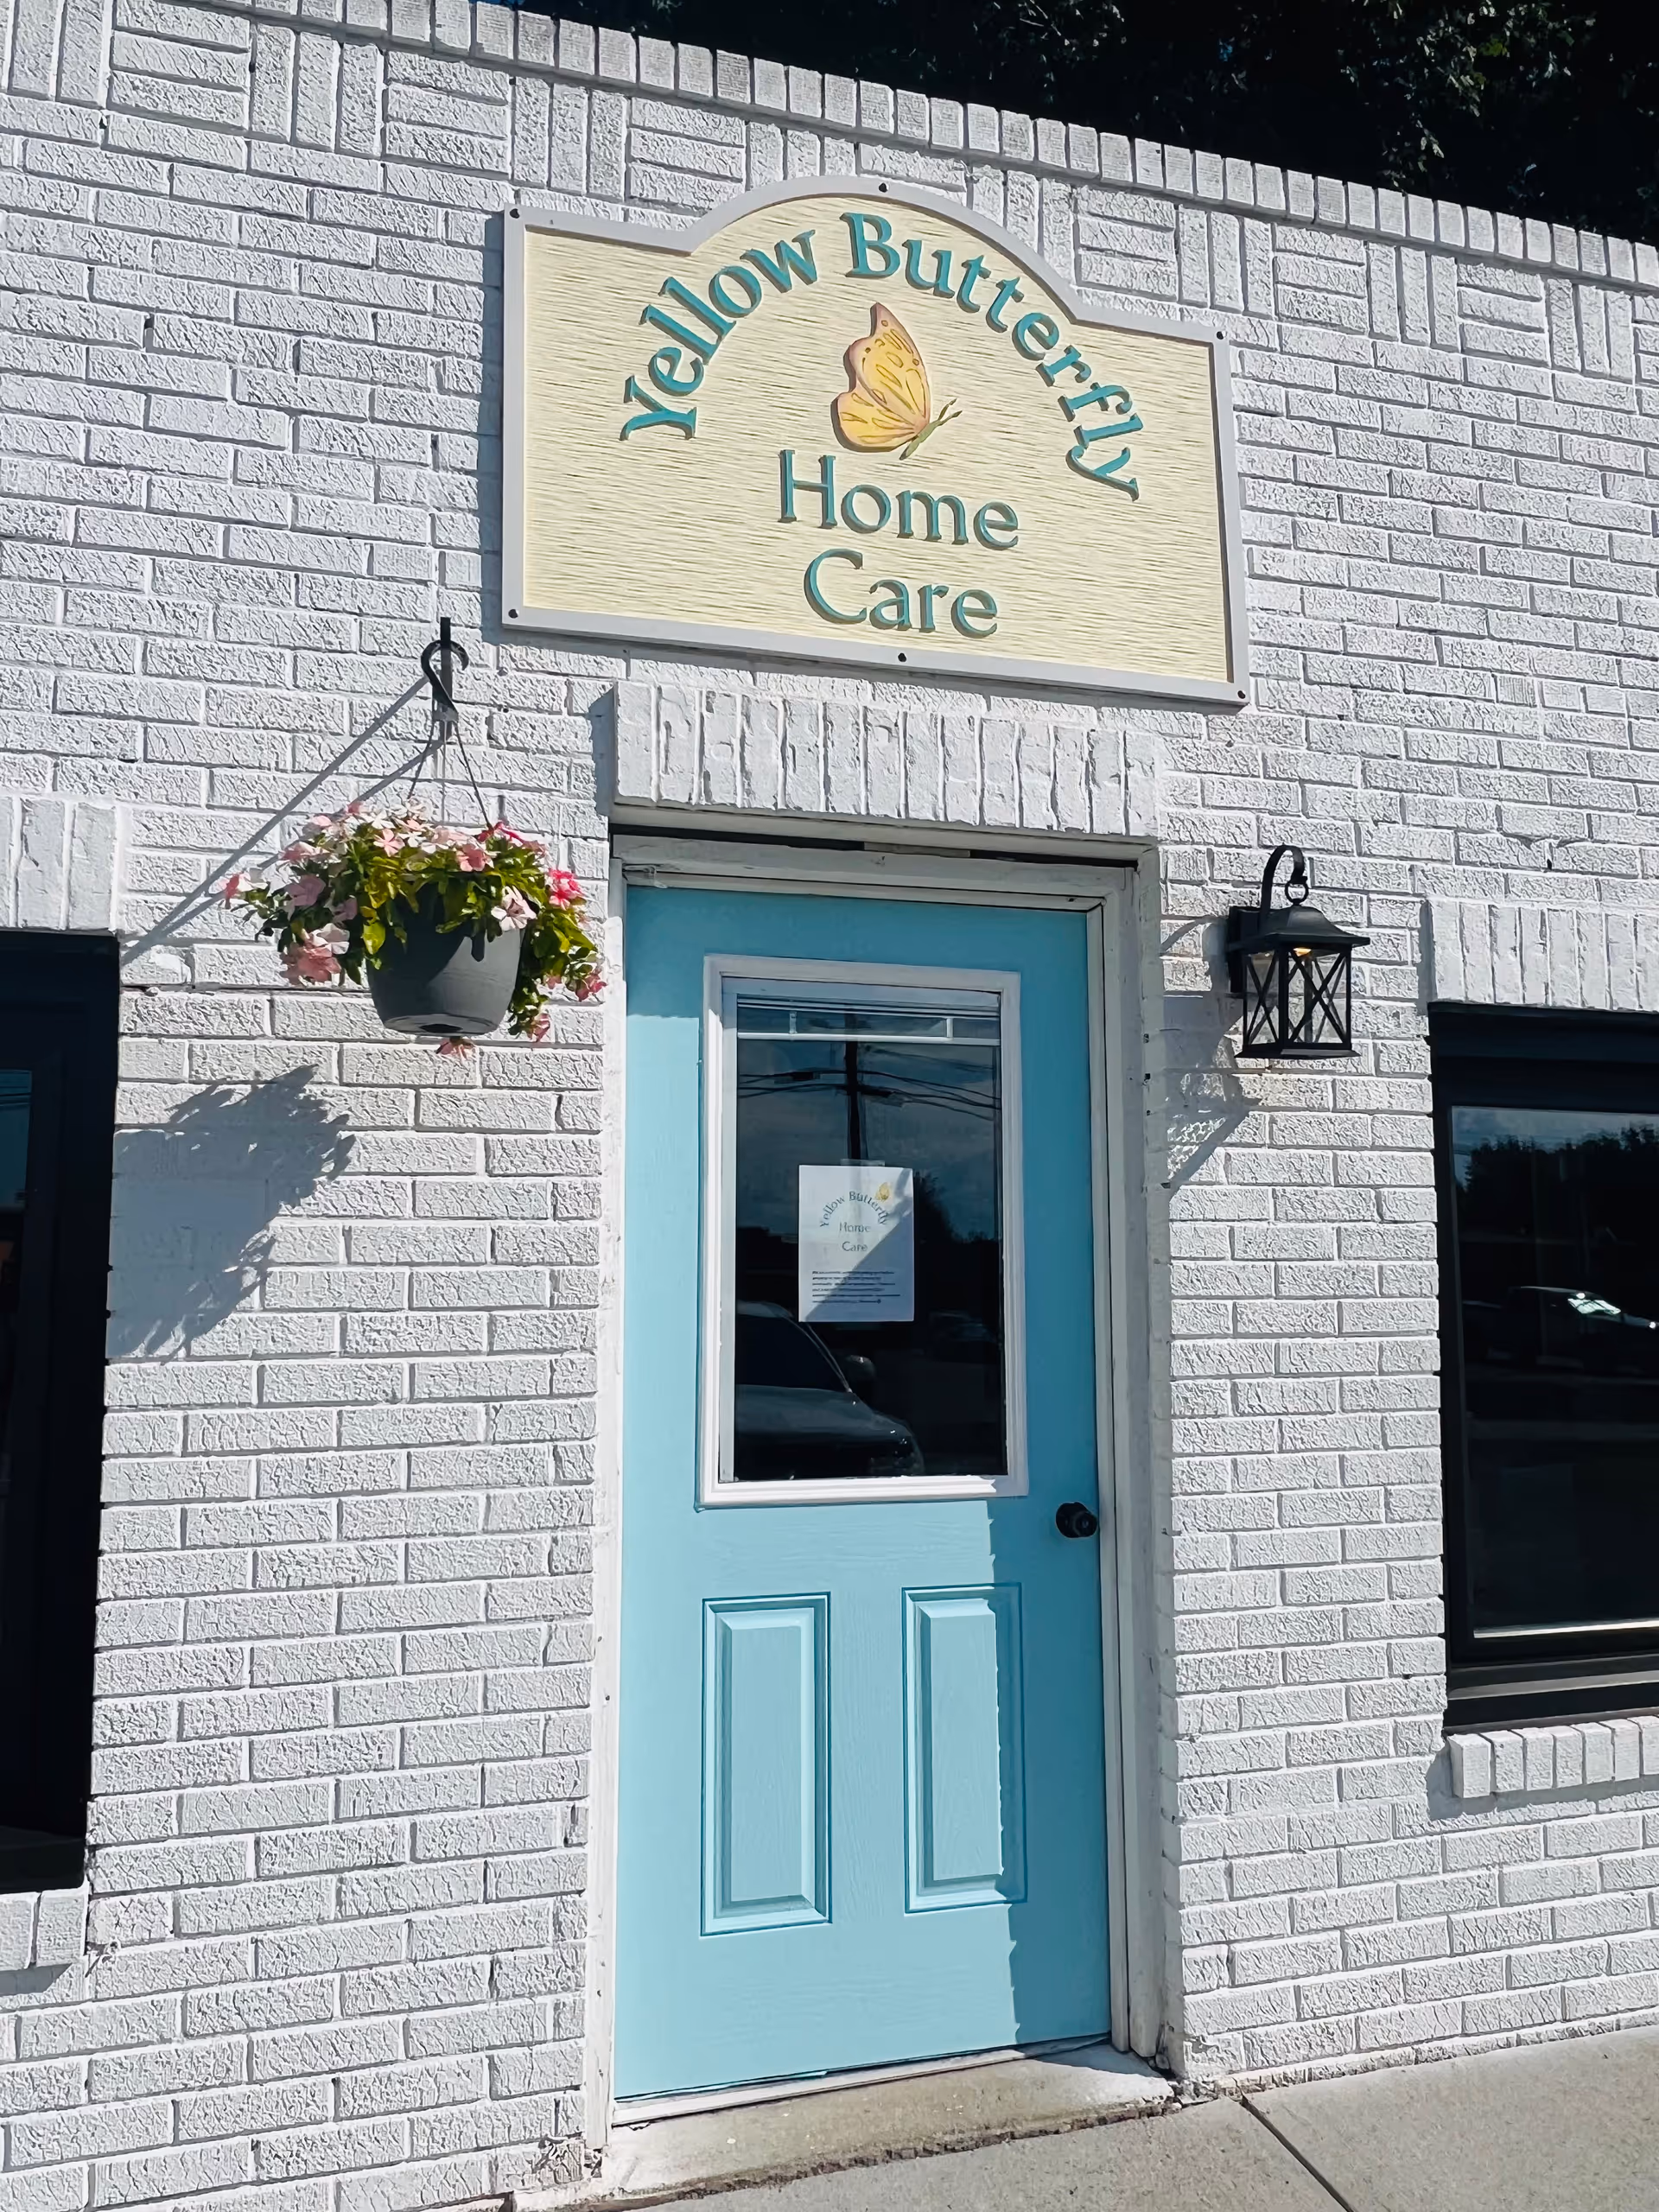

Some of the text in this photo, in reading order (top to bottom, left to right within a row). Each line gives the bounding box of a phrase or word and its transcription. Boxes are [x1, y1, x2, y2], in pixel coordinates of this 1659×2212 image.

[620, 212, 1144, 501] Yellow Butterfly
[779, 448, 1019, 551] Home
[804, 548, 998, 639] Care
[820, 1191, 890, 1228] Yellow Butterfly
[839, 1222, 871, 1233] Home
[842, 1241, 868, 1252] Care
